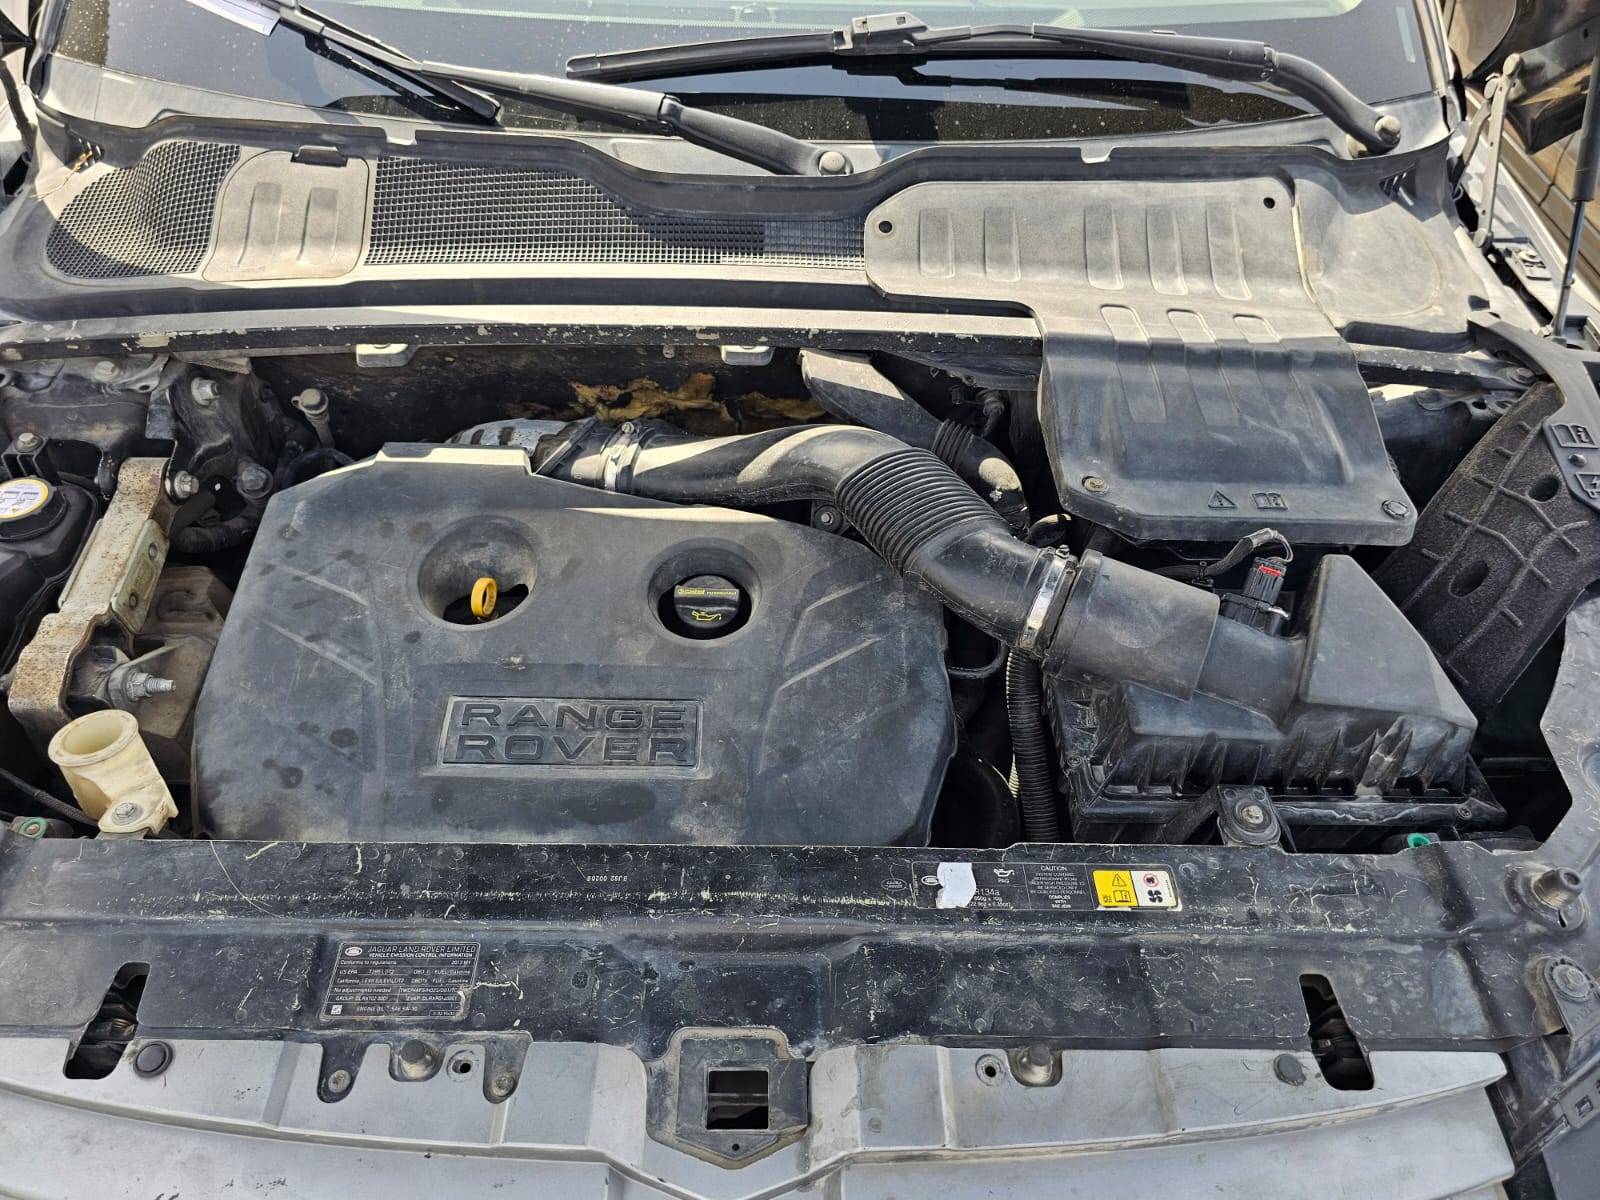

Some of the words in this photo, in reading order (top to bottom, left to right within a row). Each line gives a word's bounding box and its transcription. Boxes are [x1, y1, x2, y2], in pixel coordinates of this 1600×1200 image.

[461, 703, 687, 730] RANGE
[455, 734, 688, 762] ROVER
[368, 945, 398, 953] JAGUAR
[398, 945, 419, 953] LAND
[420, 945, 446, 953] ROVER
[446, 945, 476, 953] LIMITED
